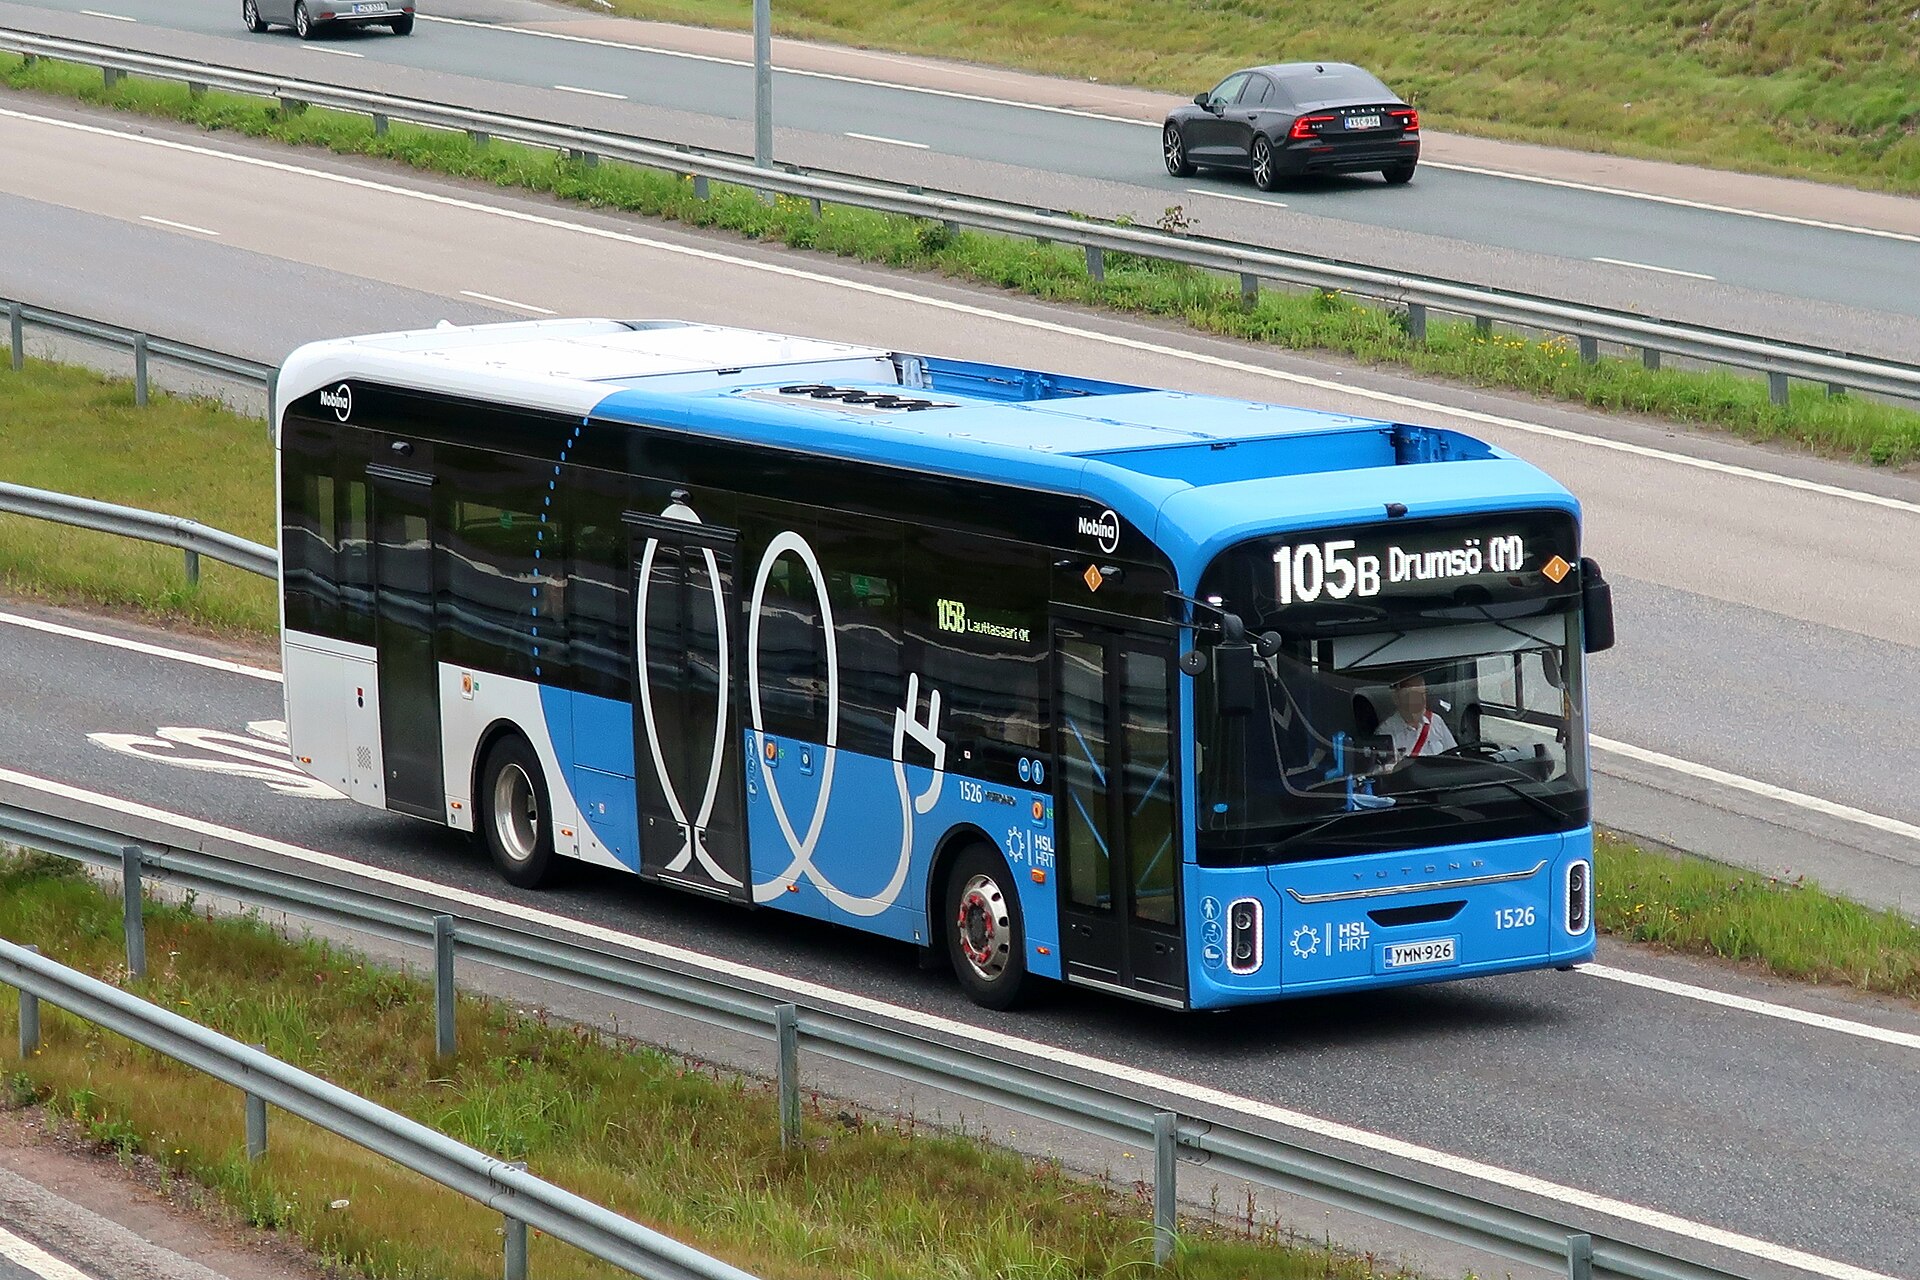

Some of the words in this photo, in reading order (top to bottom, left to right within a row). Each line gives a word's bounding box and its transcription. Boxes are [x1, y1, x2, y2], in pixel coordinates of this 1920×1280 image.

[320, 390, 348, 409] Nobina
[1078, 516, 1115, 539] Nobina
[1389, 538, 1482, 583] Drumsö
[1489, 534, 1524, 573] (M)
[937, 598, 966, 634] 105B
[967, 618, 1018, 640] Lauttasaari
[959, 780, 983, 804] 1526
[1034, 834, 1055, 853] HSL
[1035, 850, 1055, 868] HRT
[1494, 906, 1536, 930] 1526
[1338, 921, 1370, 938] HSL
[1338, 937, 1369, 953] HRT
[1394, 943, 1452, 964] YMN-926
